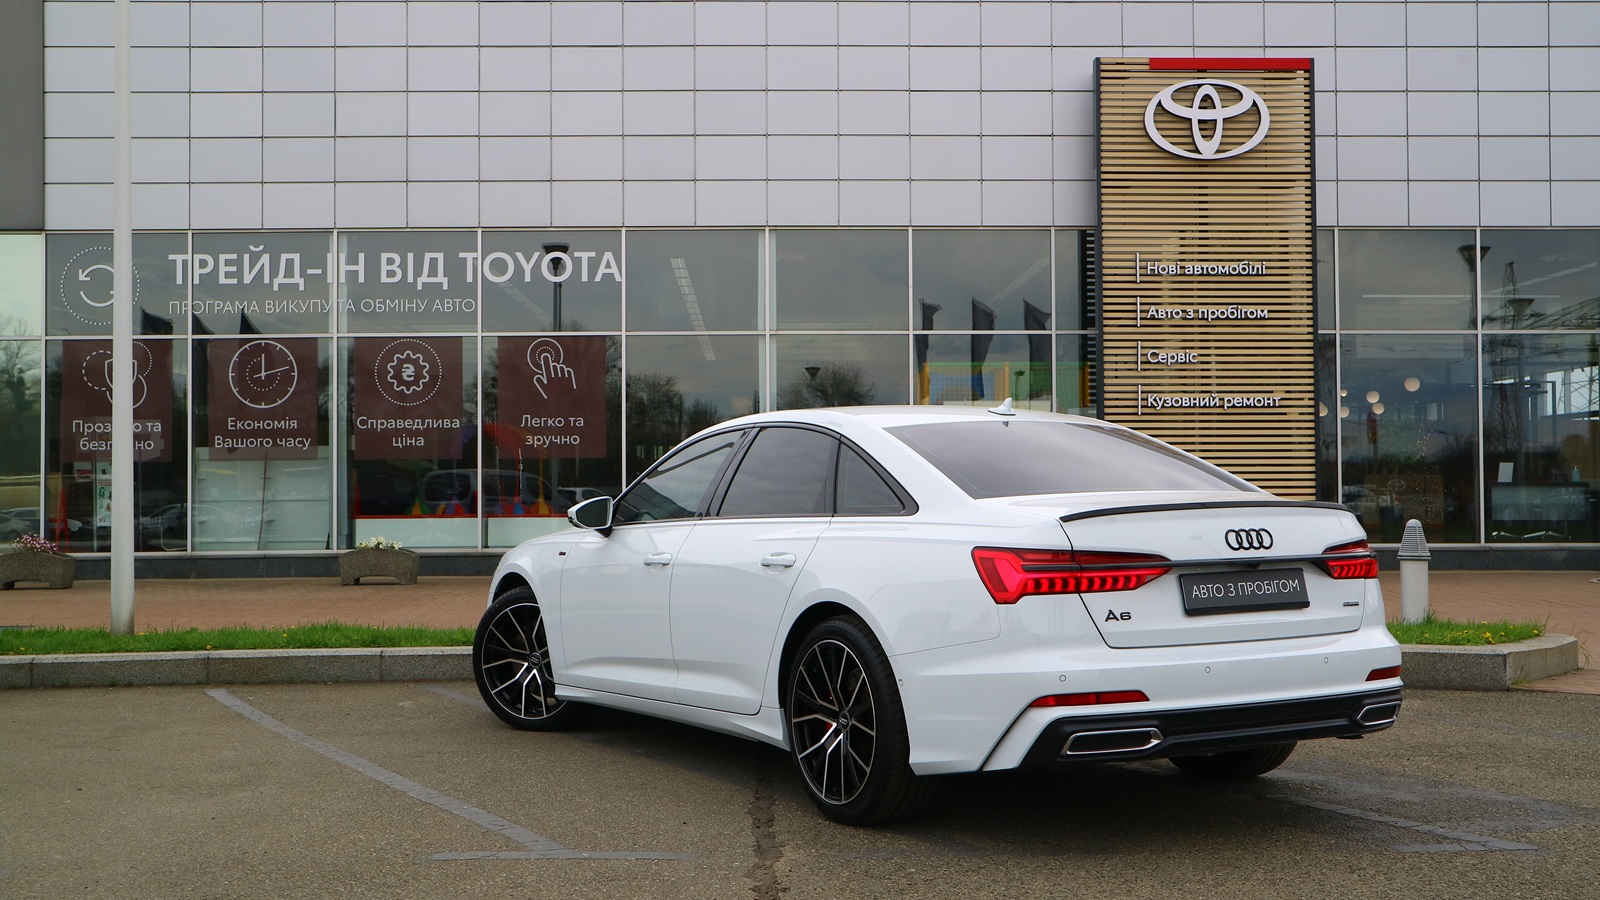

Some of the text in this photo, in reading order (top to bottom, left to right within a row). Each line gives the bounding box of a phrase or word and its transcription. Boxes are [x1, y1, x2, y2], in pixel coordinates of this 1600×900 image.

[168, 245, 622, 292] ТРЕЙД-ІН ВІД TOYOTA
[1146, 260, 1267, 275] Нові автомобілі
[169, 300, 260, 315] ПРОГРАМА
[265, 299, 334, 314] ВИКУПУ
[360, 298, 428, 314] ОБМІНУ
[432, 298, 476, 312] АВТО
[1146, 305, 1269, 322] Авто з пробігом
[1147, 349, 1199, 366] Сервіс
[1146, 392, 1281, 411] Кузовний ремонт
[72, 420, 162, 436] Прозо та
[227, 416, 298, 431] Економія
[356, 416, 460, 431] Справедлива
[520, 414, 584, 428] Легко та
[79, 437, 154, 450] безпно
[214, 435, 312, 450] Вашого часу
[392, 434, 425, 449] ціна
[525, 435, 580, 448] зручно
[1192, 584, 1225, 599] АВТО
[1238, 578, 1300, 596] ПРОБІГОМ
[1104, 609, 1132, 622] A6
